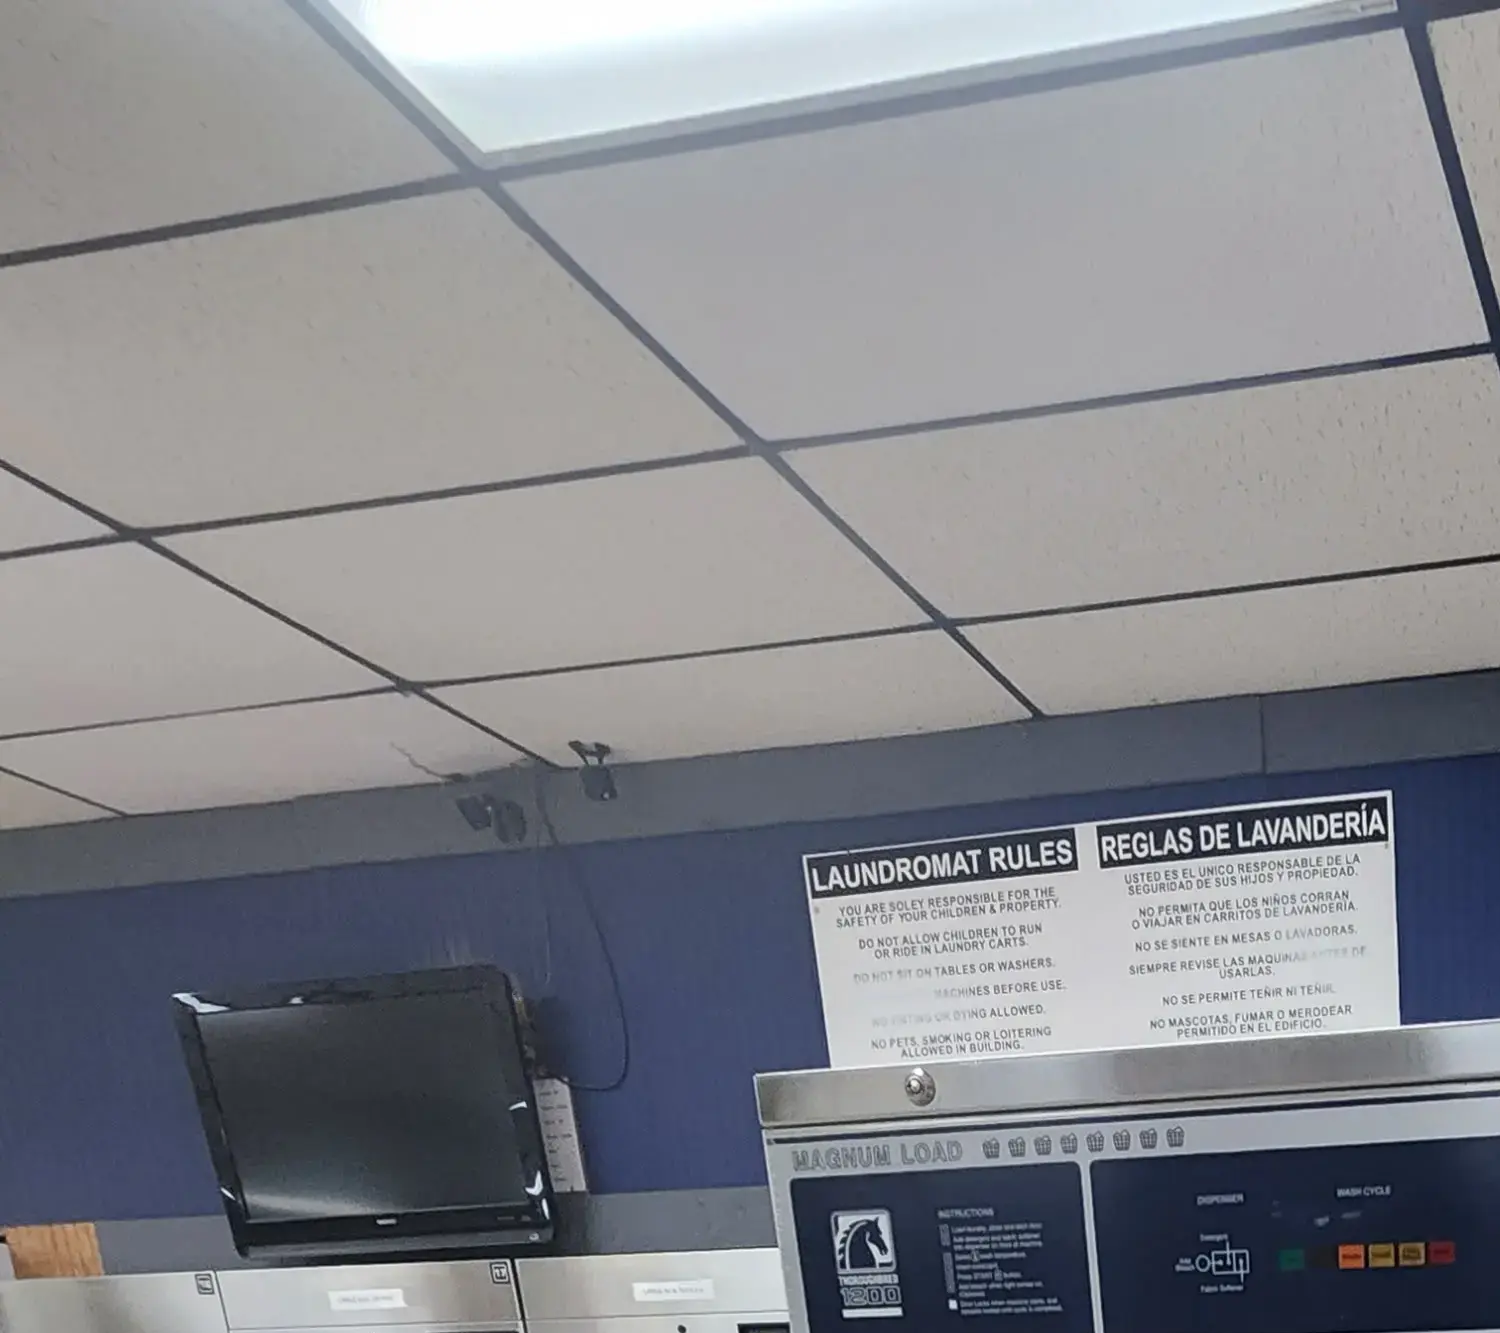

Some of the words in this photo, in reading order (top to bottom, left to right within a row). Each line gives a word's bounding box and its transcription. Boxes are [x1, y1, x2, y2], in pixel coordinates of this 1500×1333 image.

[1101, 827, 1192, 862] REGLAS
[1200, 824, 1231, 851] DE
[1238, 803, 1385, 848] LAVANDERÍA
[812, 849, 981, 891] LAUNDROMAT
[990, 839, 1073, 871] RULES
[1124, 872, 1160, 884] USTED
[1165, 870, 1178, 880] ES
[1182, 869, 1194, 879] EL
[1199, 865, 1233, 878] UNICO
[1238, 857, 1322, 873] RESPONSABLE
[1327, 856, 1342, 866] DE
[1346, 854, 1360, 864] LA
[1128, 880, 1192, 895] SEGURIDAD
[1197, 878, 1211, 889] DE
[1215, 876, 1237, 888] SUS
[1241, 873, 1273, 884] HIJOS
[1277, 872, 1284, 881] Y
[1288, 866, 1358, 881] PROPIEDAD.
[839, 905, 861, 916] YOU
[864, 904, 885, 914] ARE
[890, 900, 925, 912] SOLEY
[928, 893, 1005, 909] RESPONSIBLE
[1008, 889, 1030, 899] FOR
[1034, 887, 1055, 898] THE
[1139, 908, 1154, 918] NO
[1158, 902, 1205, 916] PERMITA
[1209, 900, 1232, 912] QUE
[1236, 898, 1258, 908] LOS
[1262, 894, 1296, 906] NIÑOS
[1300, 891, 1349, 902] CORRAN
[837, 915, 876, 928] SAFETY
[881, 913, 894, 924] OF
[898, 911, 928, 923] YOUR
[931, 905, 985, 920] CHILDREN
[990, 905, 996, 914] &
[1000, 899, 1061, 913] PROPERTY.
[1132, 920, 1140, 930] O
[1144, 916, 1183, 928] VIAJAR
[1187, 914, 1200, 924] EN
[1204, 909, 1260, 923] CARRITOS
[1264, 908, 1279, 918] DE
[859, 938, 874, 950] DO
[878, 936, 898, 947] NOT
[903, 932, 940, 945] ALLOW
[944, 927, 998, 942] CHILDREN
[1002, 926, 1016, 935] TO
[1020, 923, 1042, 934] RUN
[875, 948, 890, 959] OR
[894, 945, 917, 957] RIDE
[921, 944, 931, 954] IN
[935, 940, 985, 954] LAUNDRY
[989, 937, 1029, 949] CARTS.
[1136, 942, 1150, 952] NO
[1154, 940, 1168, 950] SE
[1171, 937, 1209, 949] SIENTE
[1214, 936, 1228, 945] EN
[1232, 932, 1270, 944] MESAS
[1275, 931, 1282, 939] O
[1286, 925, 1357, 939] LAVADORAS.
[873, 971, 893, 982] NOT
[935, 964, 976, 977] TABLES
[979, 962, 995, 973] OR
[998, 958, 1056, 972] WASHERS.
[1129, 963, 1177, 975] SIEMPRE
[1180, 959, 1220, 971] REVISE
[1223, 957, 1244, 967] LAS
[1220, 966, 1275, 979] USARLAS.
[993, 982, 1038, 995] BEFORE
[1041, 980, 1067, 990] USE.
[1163, 997, 1178, 1005] NO
[1181, 994, 1195, 1005] SE
[1199, 991, 1246, 1004] PERMITE
[1286, 987, 1297, 996] NI
[990, 1005, 1046, 1018] ALLOWED.
[1150, 1020, 1164, 1029] NO
[1168, 1015, 1232, 1028] MASCOTAS,
[1235, 1011, 1273, 1023] FUMAR
[1289, 1005, 1352, 1018] MERODEAR
[871, 1039, 886, 1050] NO
[923, 1033, 971, 1046] SMOKING
[975, 1031, 989, 1040] OR
[993, 1027, 1052, 1039] LOITERING
[1177, 1025, 1236, 1038] PERMITIDO
[1240, 1024, 1254, 1033] EN
[1258, 1023, 1272, 1032] EL
[1275, 1018, 1326, 1031] EDIFICIO.
[901, 1045, 952, 1058] ALLOWED
[956, 1044, 966, 1054] IN
[970, 1040, 1024, 1052] BUILDING.
[791, 1144, 891, 1171] MAGNUM
[901, 1140, 963, 1165] LOAD
[1337, 1188, 1361, 1197] WASH
[1363, 1185, 1391, 1196] CYCLE
[840, 1285, 901, 1306] 1200
